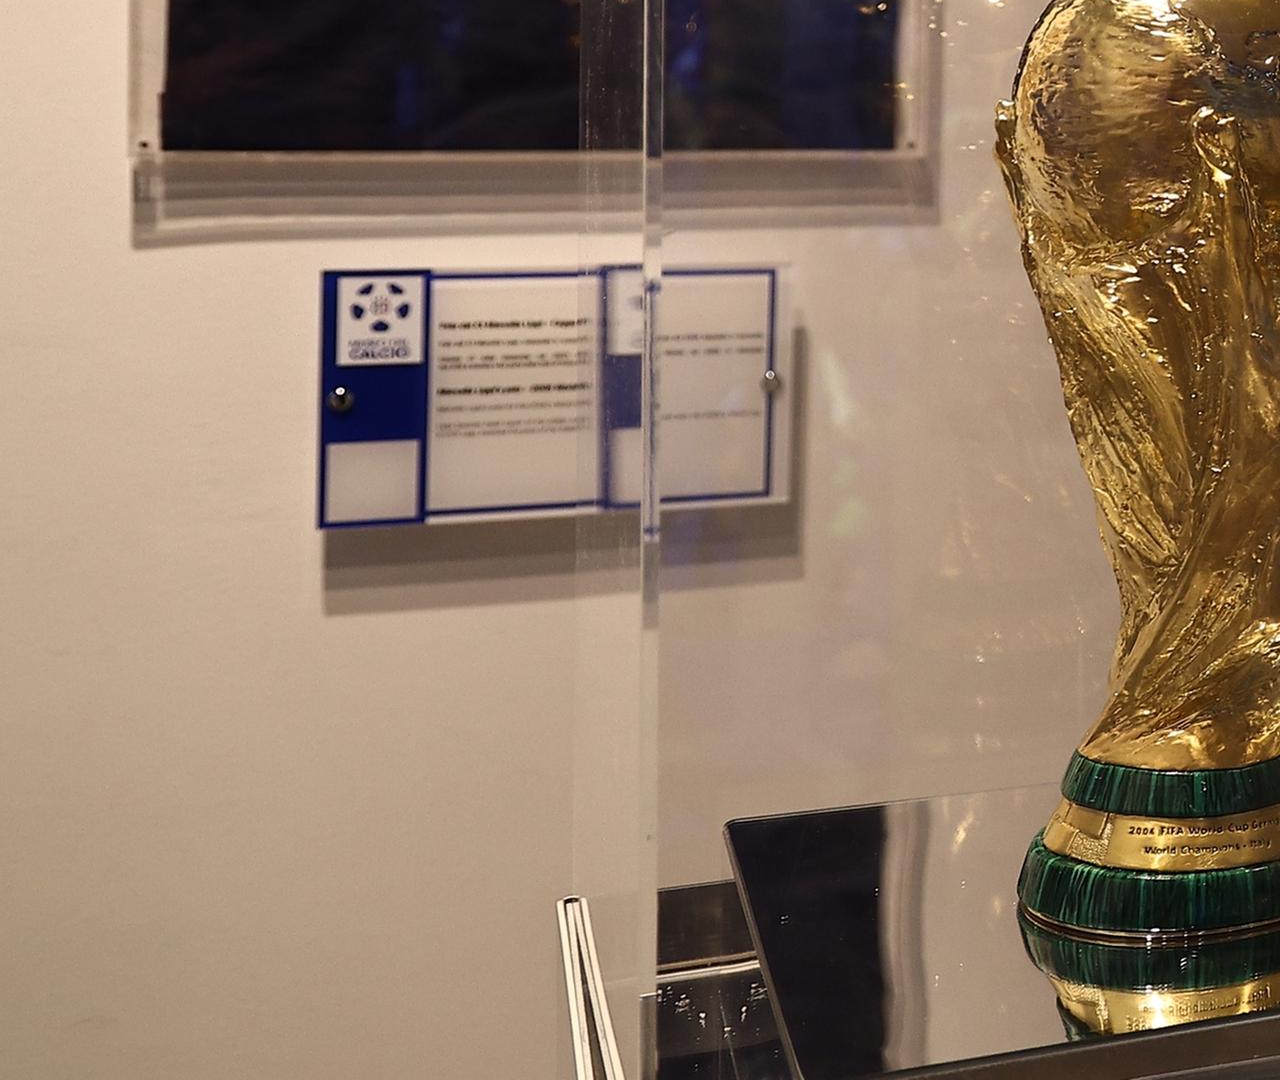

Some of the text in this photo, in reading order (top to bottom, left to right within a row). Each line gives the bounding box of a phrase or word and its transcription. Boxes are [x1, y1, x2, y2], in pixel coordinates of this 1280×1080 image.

[1160, 825, 1184, 835] FIFA
[1188, 824, 1223, 835] World
[1228, 822, 1249, 832] Cup
[1143, 845, 1177, 855] World
